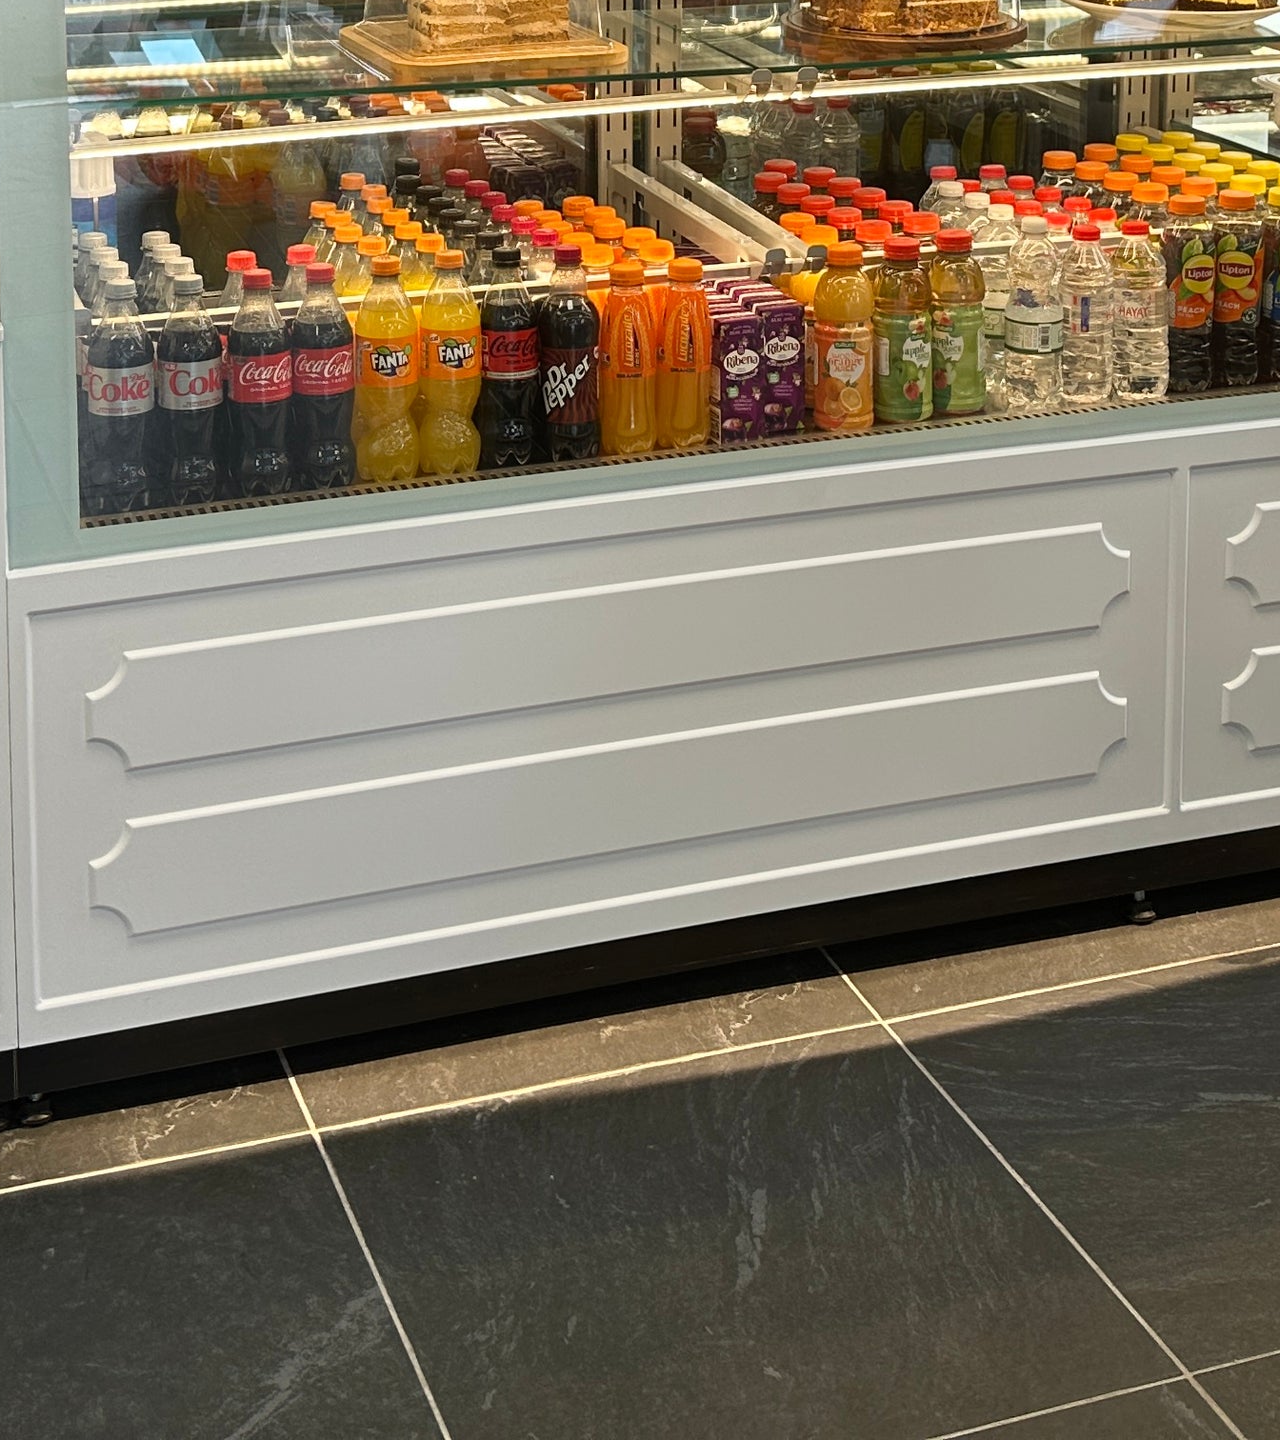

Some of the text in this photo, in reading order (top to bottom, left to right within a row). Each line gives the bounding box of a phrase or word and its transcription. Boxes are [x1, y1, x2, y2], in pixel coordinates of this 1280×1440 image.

[1188, 270, 1212, 279] Lipton
[1222, 265, 1250, 274] Lipton
[1119, 306, 1151, 317] HAYAT
[438, 343, 474, 361] FANTA
[767, 342, 798, 354] Ribena
[240, 355, 292, 385] Coca-Co
[371, 353, 408, 370] FANTA
[727, 355, 757, 368] Ribena
[169, 368, 222, 396] Cok
[548, 363, 568, 387] Dr
[89, 374, 150, 402] Coke
[543, 354, 590, 415] Pepper
